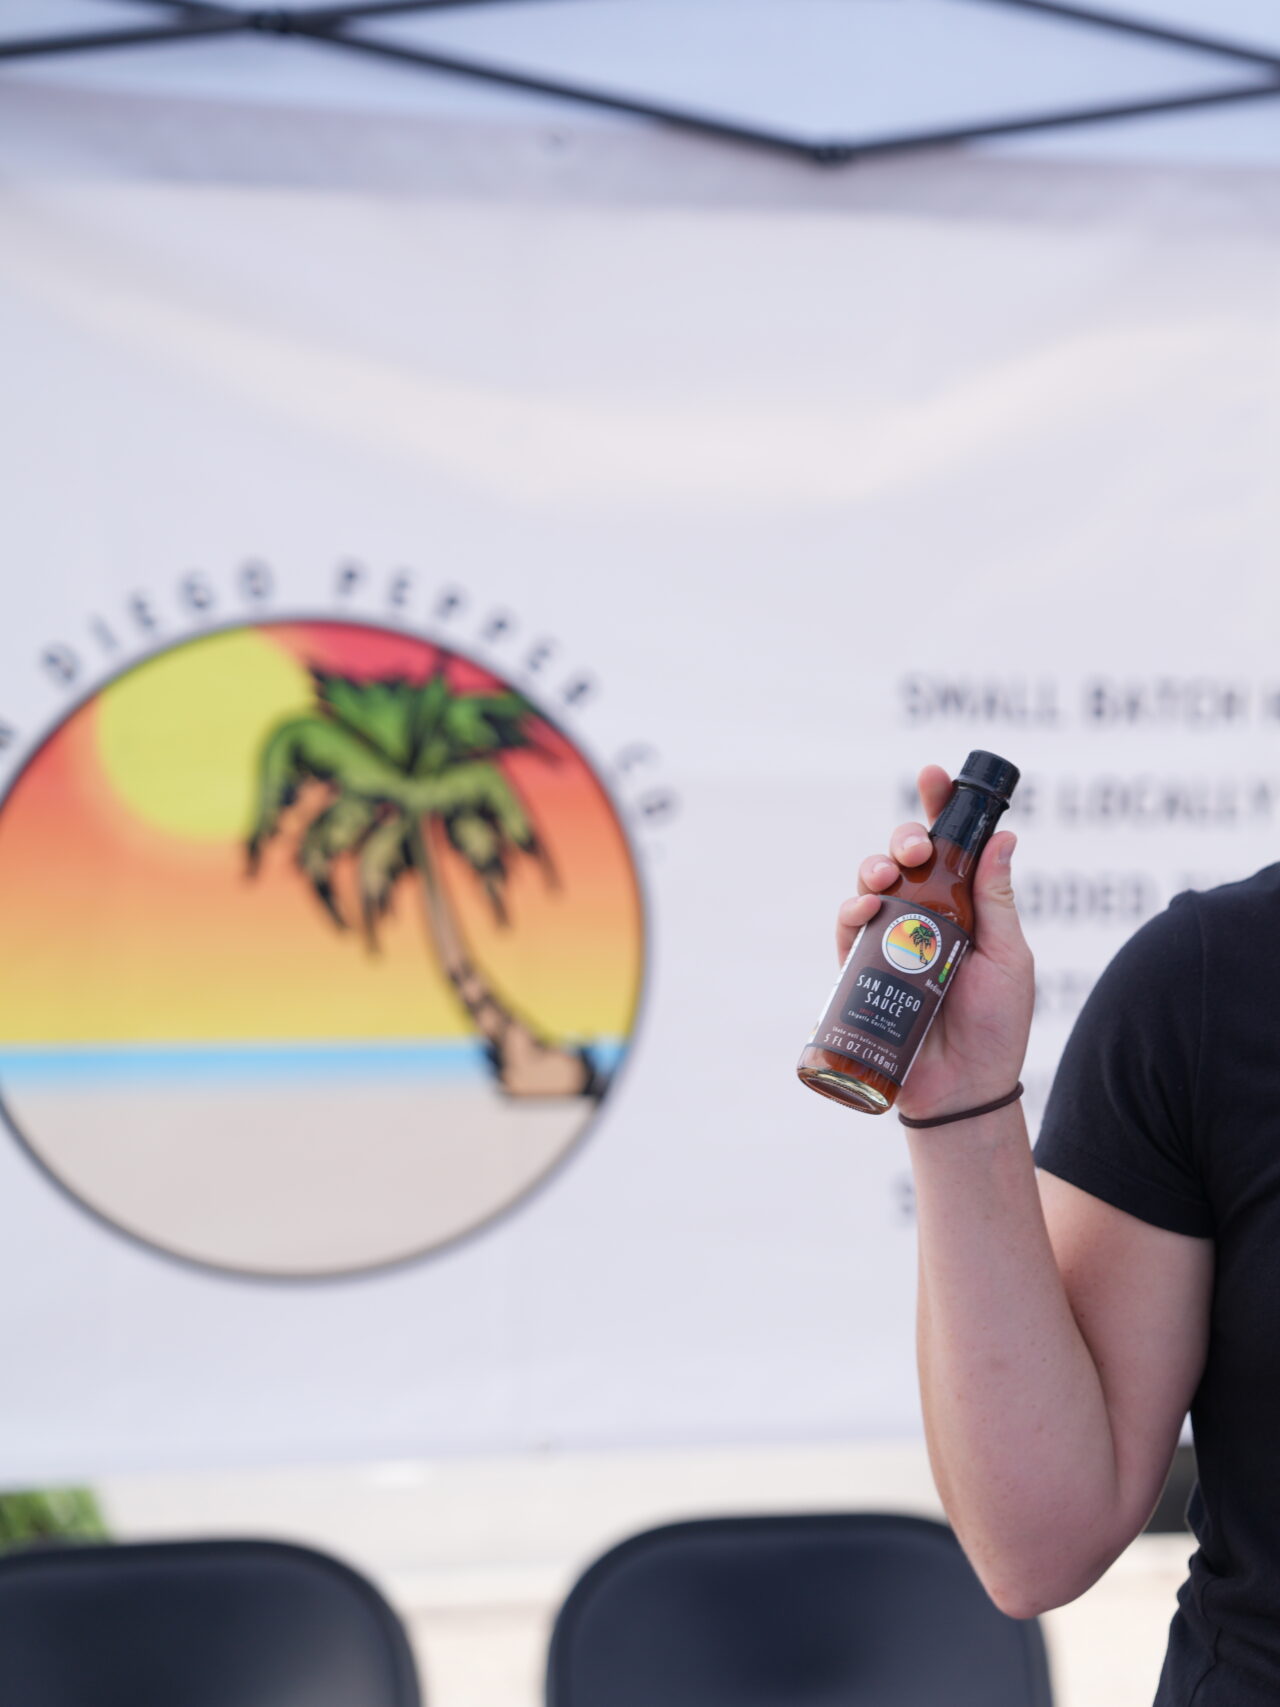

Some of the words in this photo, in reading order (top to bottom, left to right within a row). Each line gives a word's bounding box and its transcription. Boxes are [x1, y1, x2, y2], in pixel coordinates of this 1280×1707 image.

[40, 556, 276, 690] DIEGO
[336, 556, 596, 710] PEPPER
[902, 677, 1060, 730] SMALL
[1086, 677, 1244, 730] BATCH
[1055, 776, 1270, 828] LOCALLY
[856, 974, 881, 992] SAN
[884, 985, 921, 1012] DIEGO
[864, 991, 904, 1018] SAUCE
[823, 1033, 832, 1043] 5
[832, 1035, 844, 1048] FL
[846, 1040, 861, 1054] OZ
